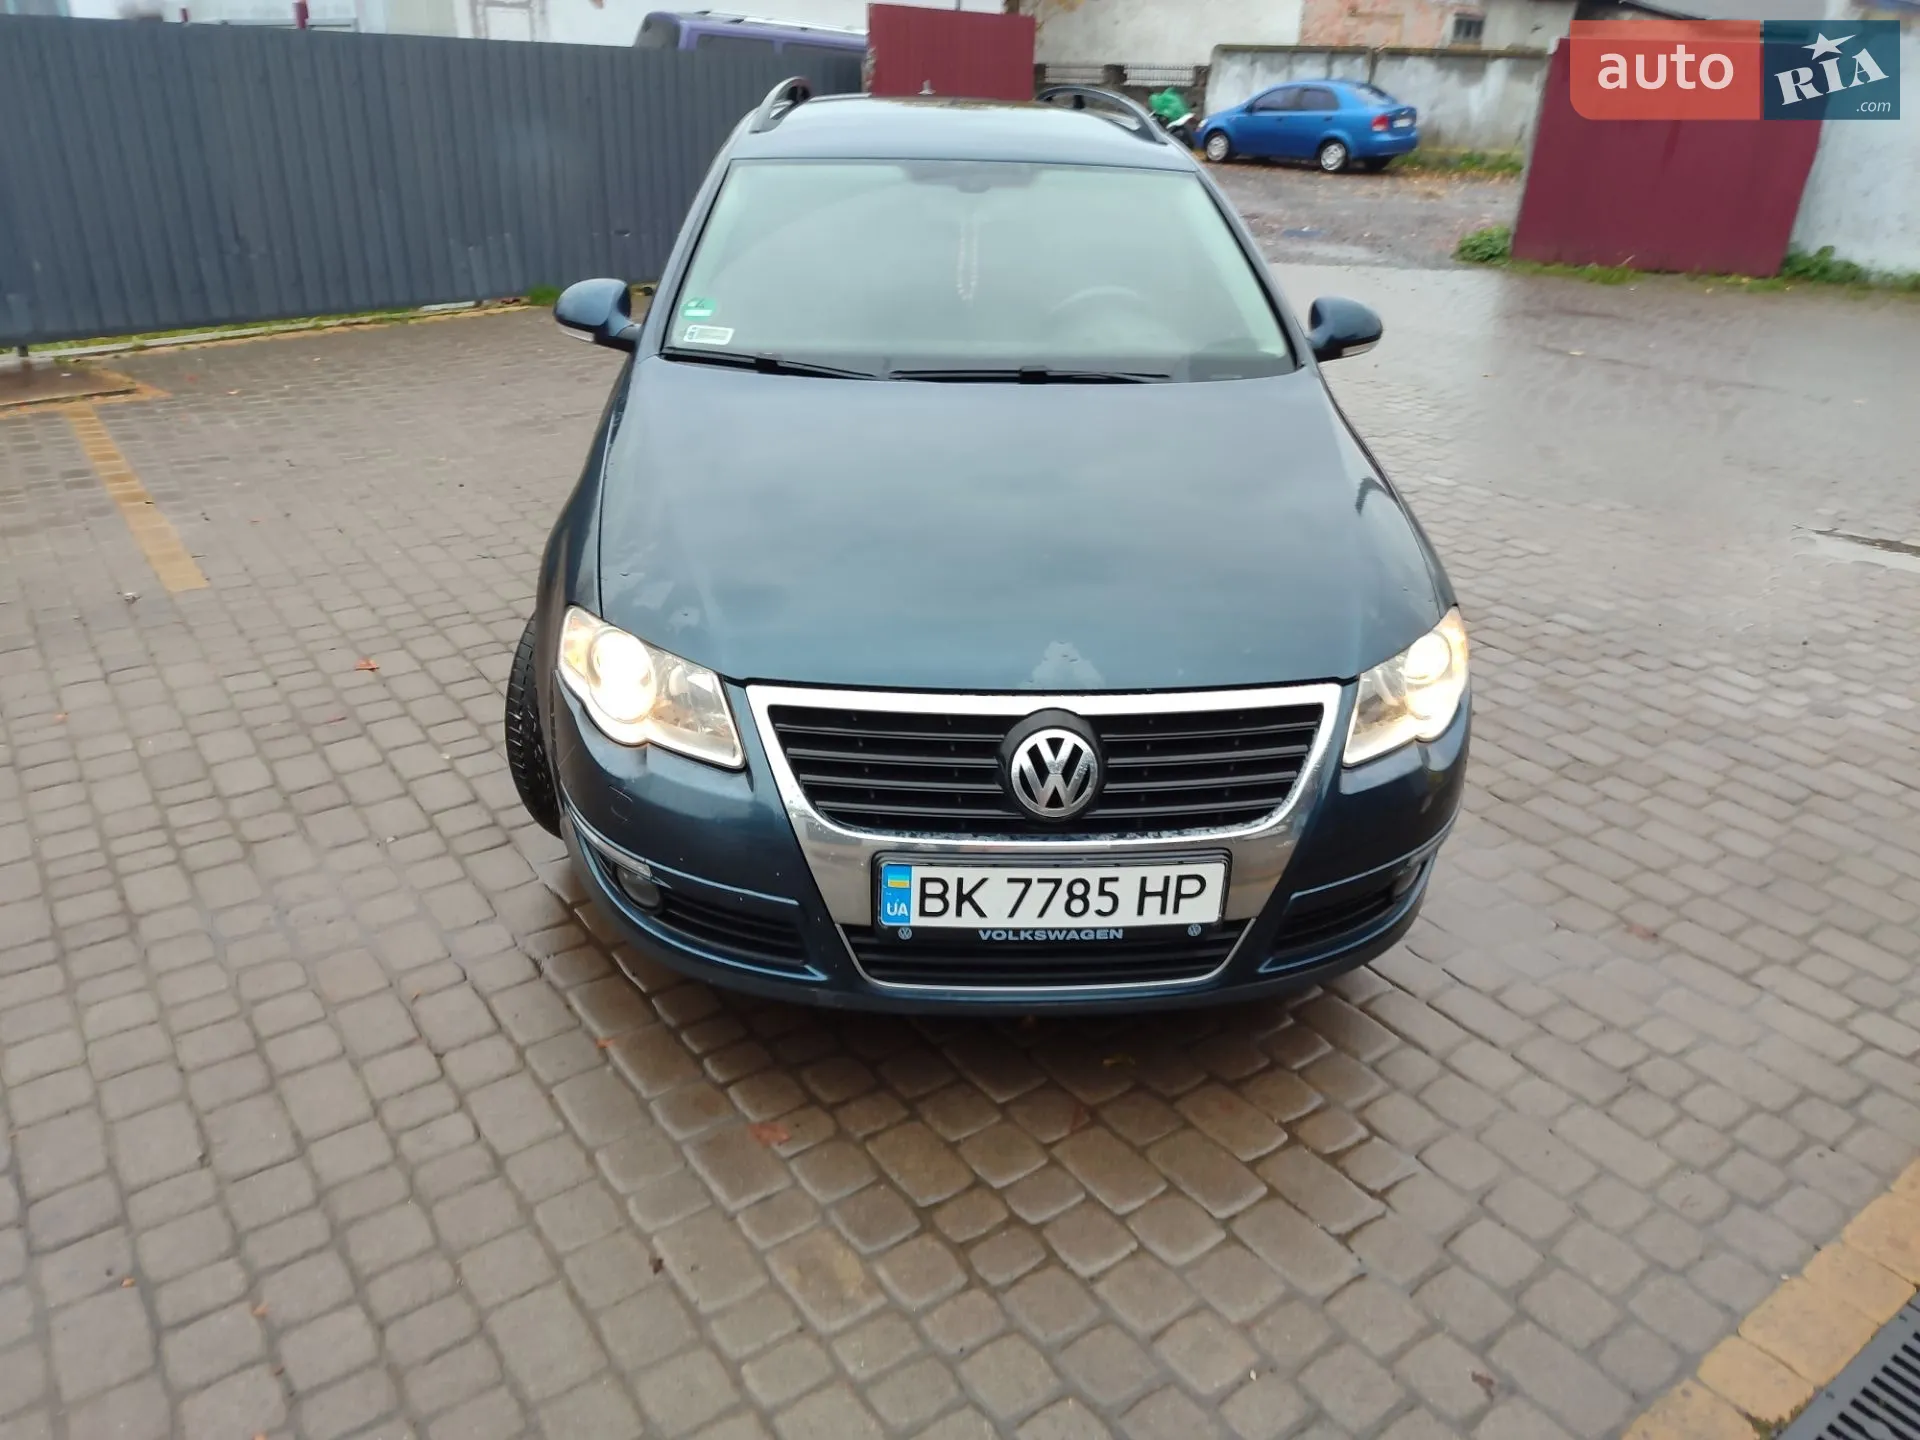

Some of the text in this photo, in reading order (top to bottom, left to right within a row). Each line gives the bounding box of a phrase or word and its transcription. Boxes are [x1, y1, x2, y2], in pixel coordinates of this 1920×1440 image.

[918, 873, 1207, 919] BK 7785 HP
[886, 901, 909, 917] UA
[978, 928, 1124, 941] VOLKSWAGEN
